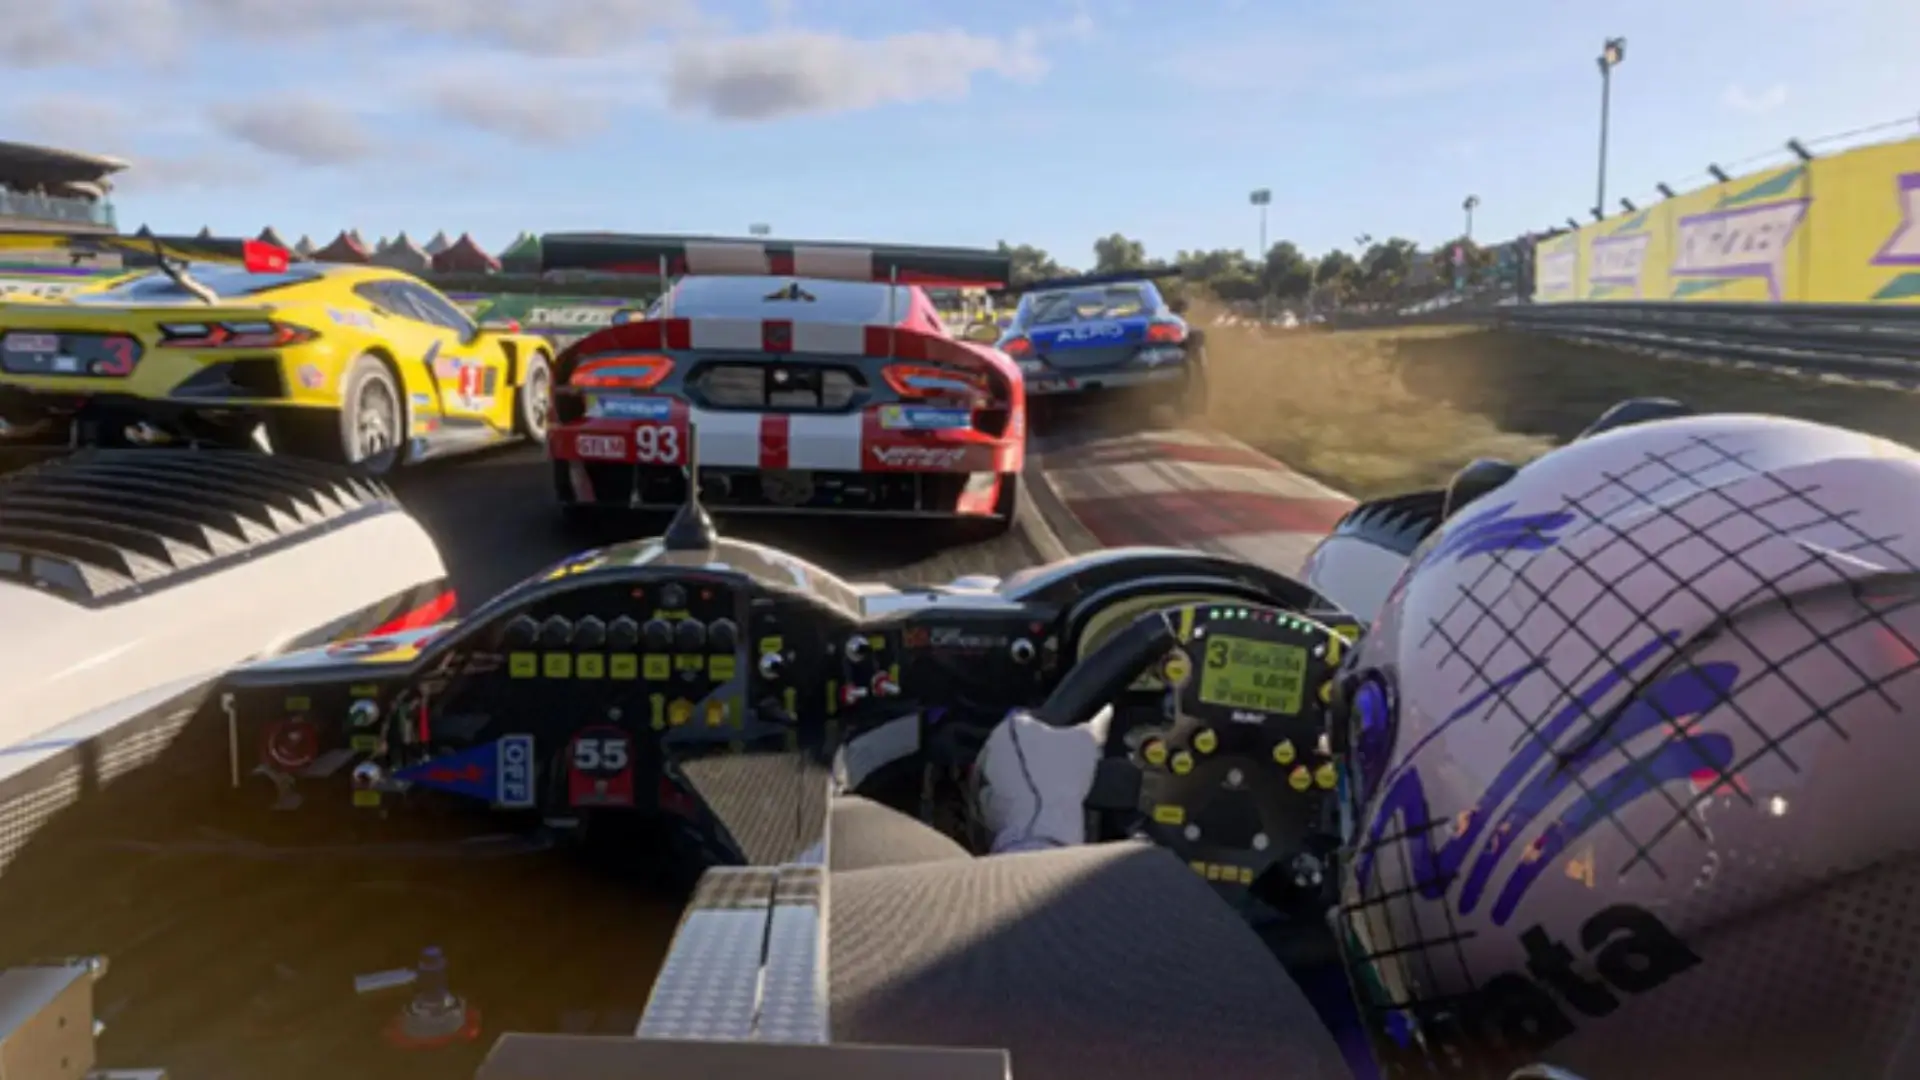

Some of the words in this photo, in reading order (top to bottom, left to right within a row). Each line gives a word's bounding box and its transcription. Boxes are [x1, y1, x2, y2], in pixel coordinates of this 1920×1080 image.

[100, 338, 134, 374] 3
[635, 425, 680, 463] 93
[1207, 640, 1228, 669] 3
[505, 741, 530, 797] OFF
[573, 737, 629, 770] 55
